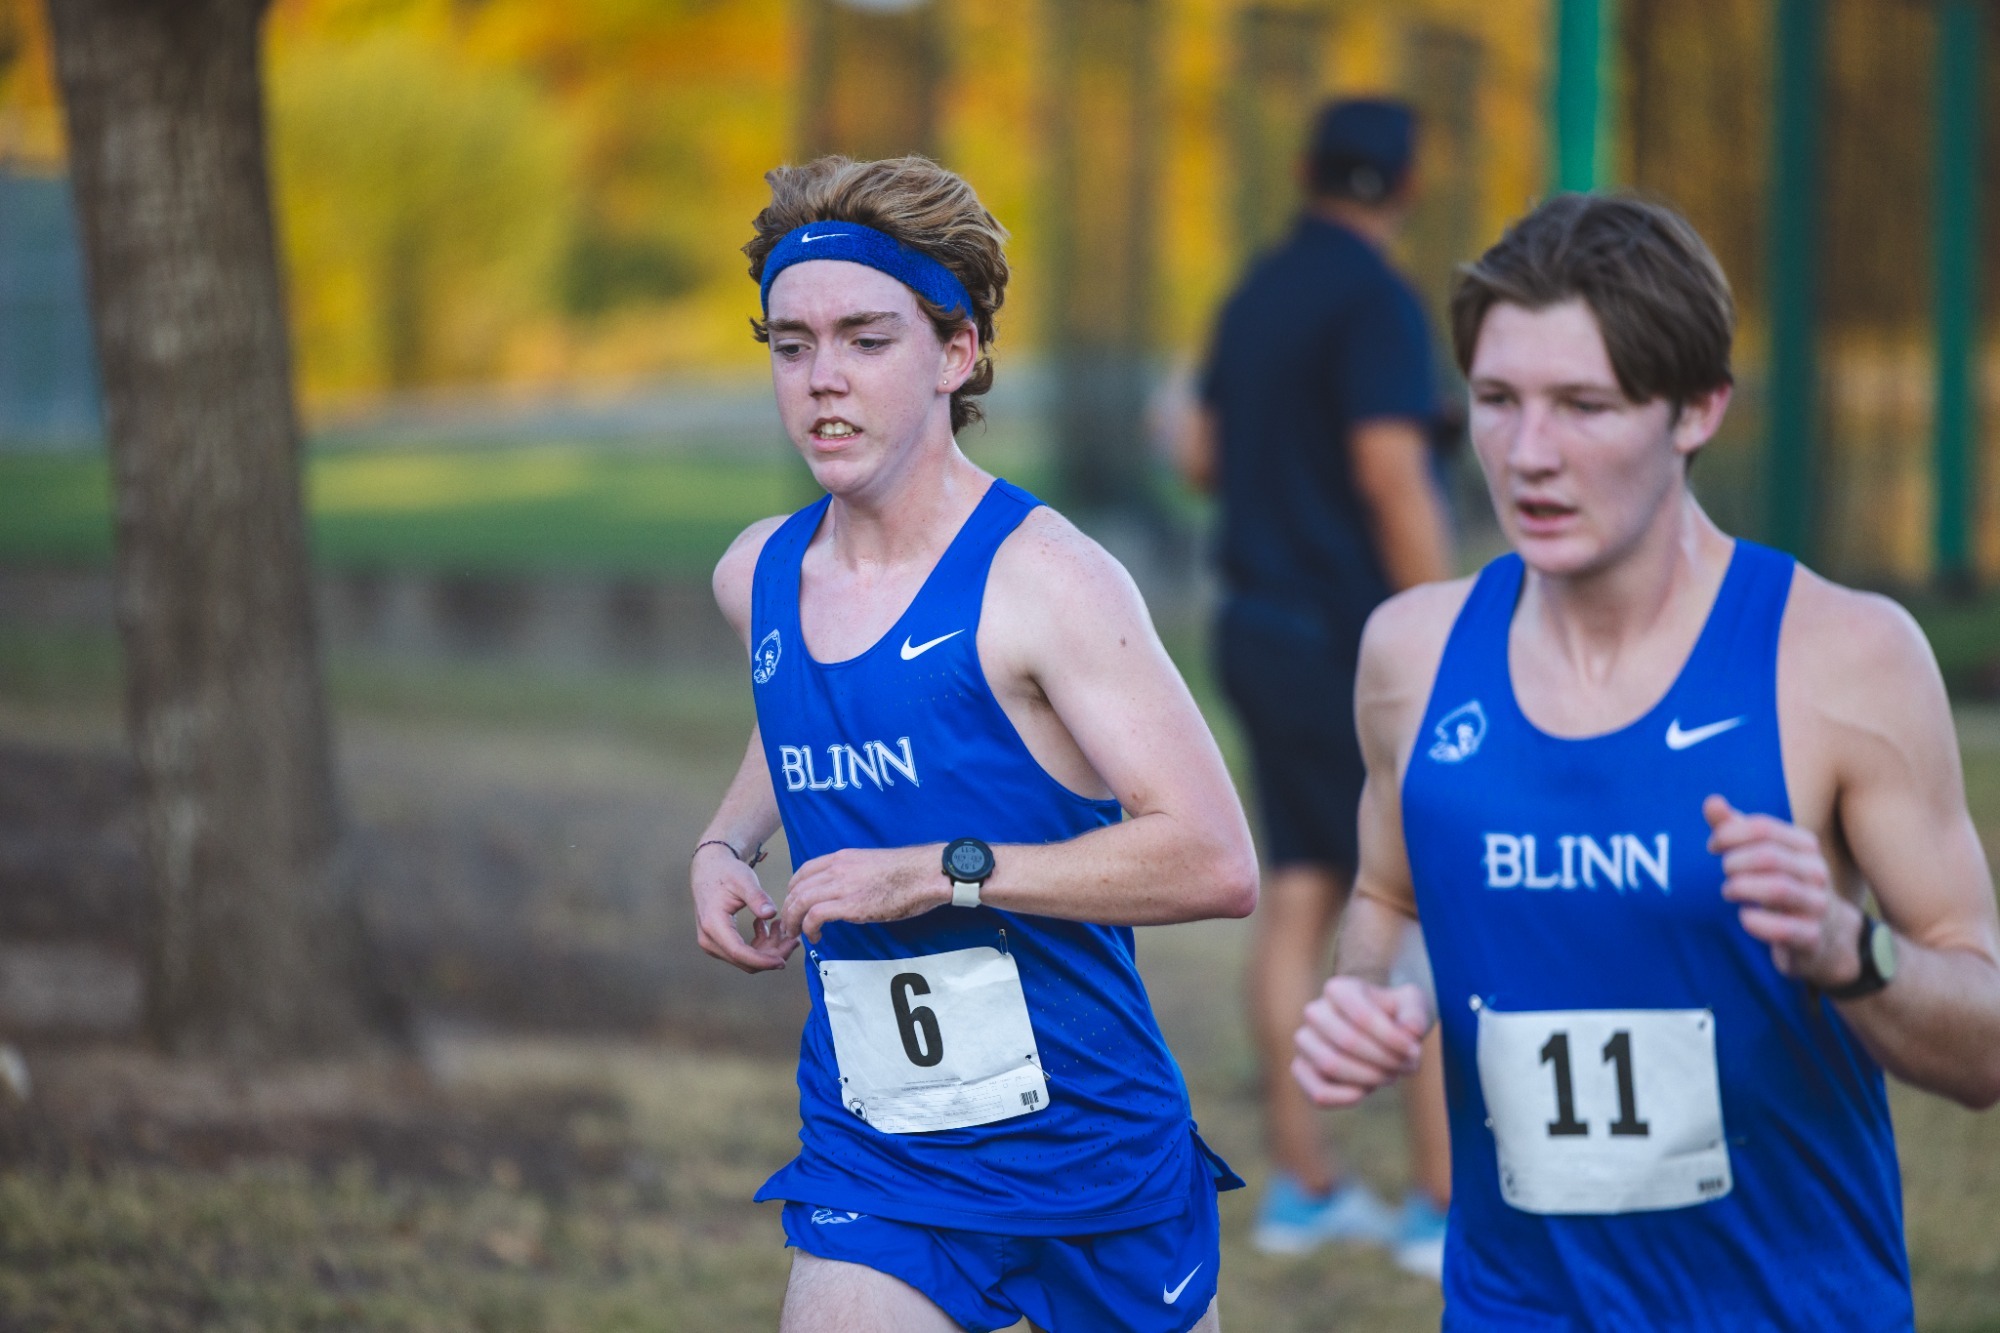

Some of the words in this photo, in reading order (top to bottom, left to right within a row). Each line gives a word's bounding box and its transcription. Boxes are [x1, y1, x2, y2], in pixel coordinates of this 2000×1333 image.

[779, 736, 920, 792] BLINN
[1482, 832, 1670, 895] BLINN
[890, 972, 944, 1067] 6
[1539, 1031, 1650, 1137] 11
